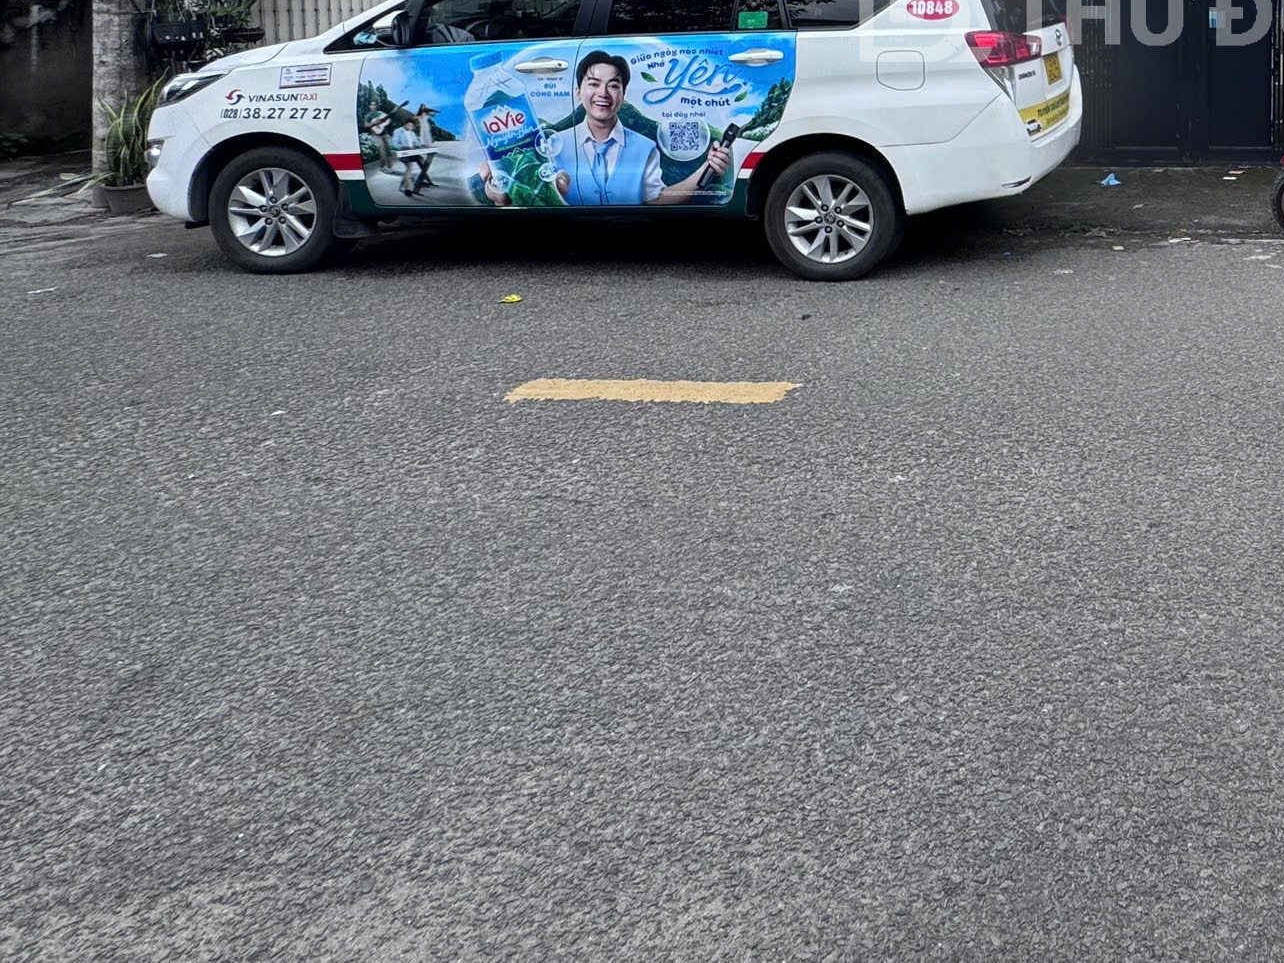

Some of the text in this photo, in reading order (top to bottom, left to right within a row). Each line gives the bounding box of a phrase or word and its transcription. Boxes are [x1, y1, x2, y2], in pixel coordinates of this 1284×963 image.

[910, 0, 953, 15] 10848
[680, 95, 731, 109] một chút
[288, 107, 309, 120] 27
[311, 108, 333, 120] 27
